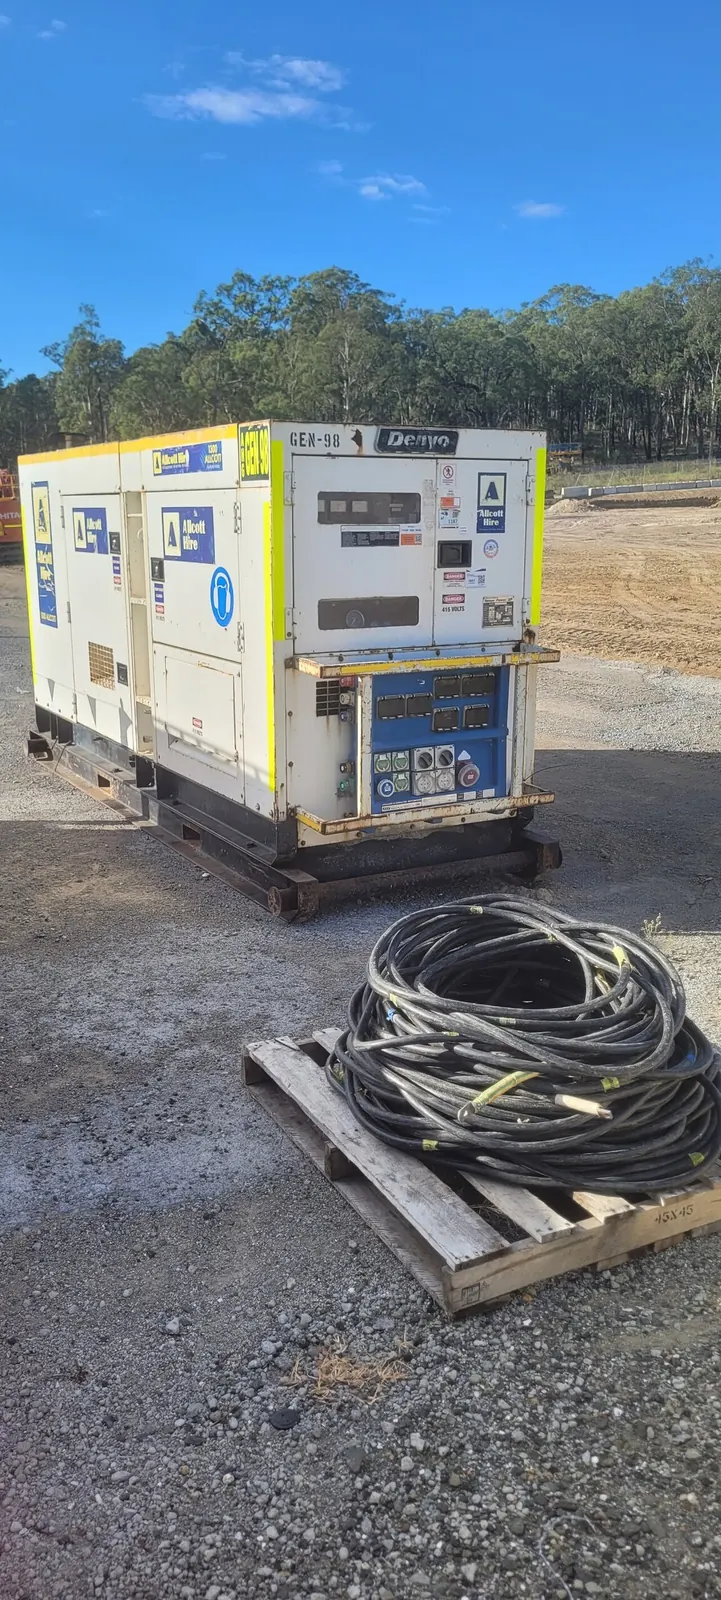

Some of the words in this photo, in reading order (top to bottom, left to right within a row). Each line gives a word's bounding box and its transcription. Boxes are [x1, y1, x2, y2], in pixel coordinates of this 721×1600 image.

[290, 432, 340, 448] GEN-98
[387, 431, 450, 450] Denyo
[479, 509, 504, 518] Allcott
[183, 519, 206, 534] Allcott
[483, 518, 499, 526] Hire
[183, 535, 198, 550] Hire
